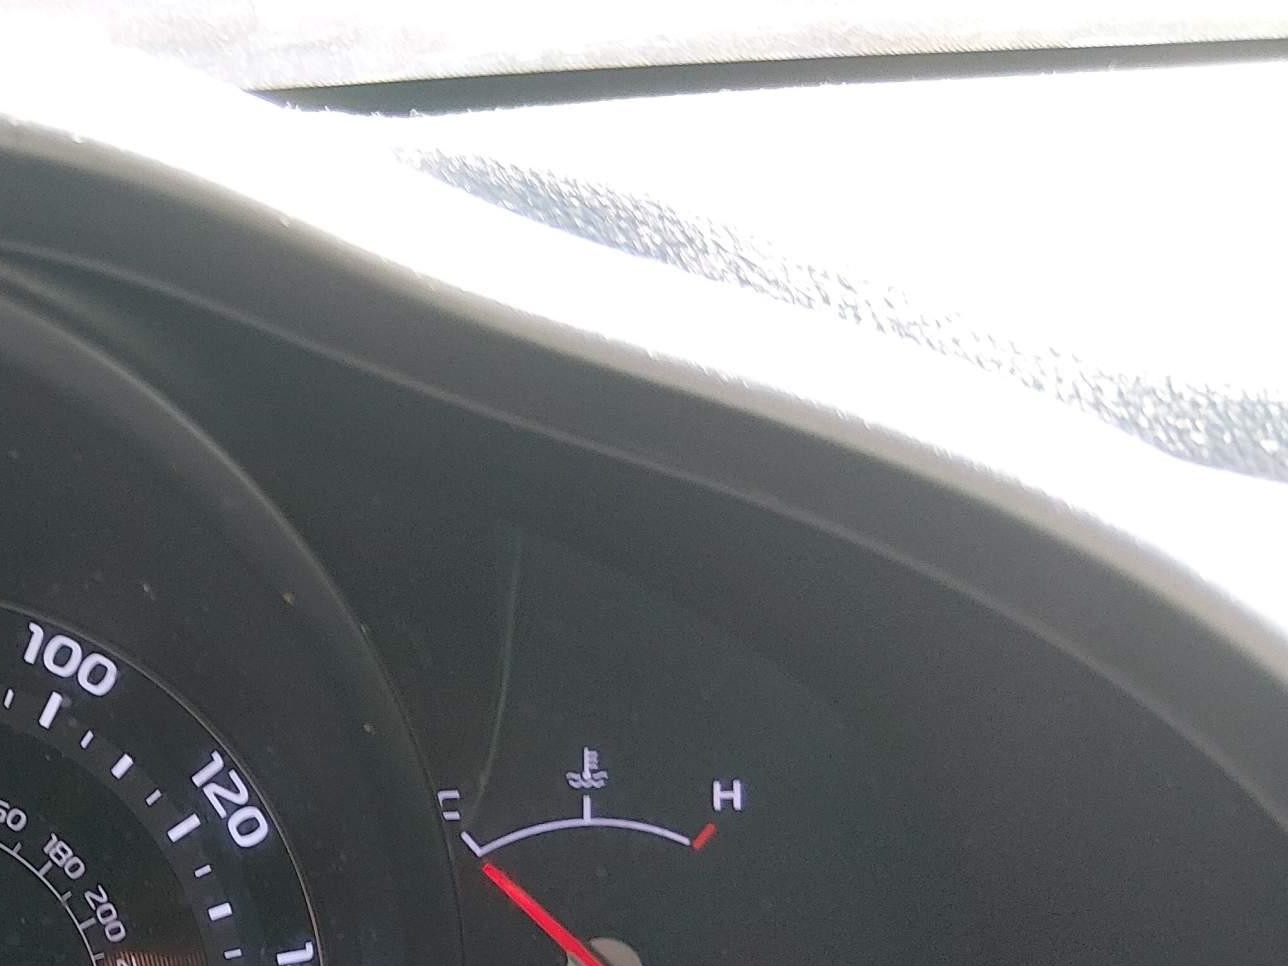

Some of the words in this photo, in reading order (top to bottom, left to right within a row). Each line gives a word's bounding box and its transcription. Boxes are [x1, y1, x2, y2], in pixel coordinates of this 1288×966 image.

[22, 621, 120, 701] 100
[189, 749, 270, 851] 120
[712, 779, 742, 812] H
[42, 833, 87, 882] 180
[82, 887, 126, 944] 200
